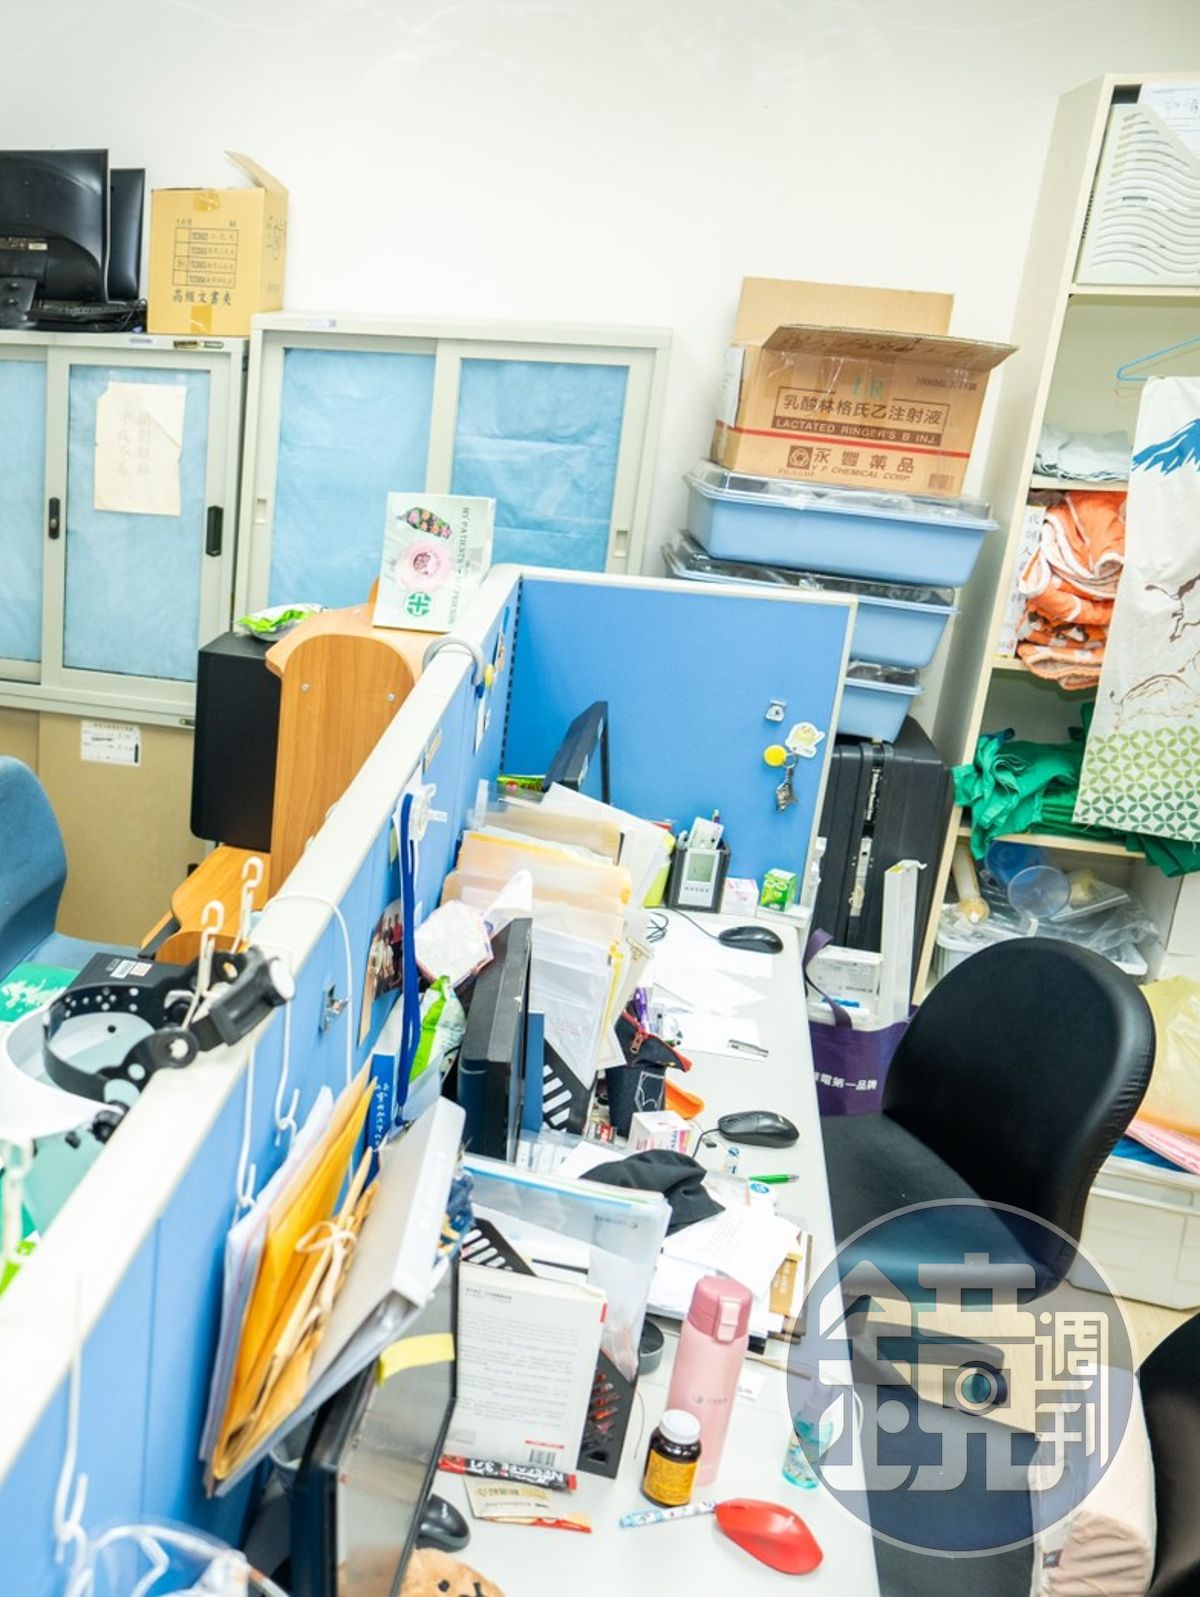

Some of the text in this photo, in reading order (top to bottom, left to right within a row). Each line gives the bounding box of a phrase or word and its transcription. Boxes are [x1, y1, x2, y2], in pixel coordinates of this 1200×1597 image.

[783, 393, 942, 426] 乳酸林格氏乙注射液
[775, 419, 939, 444] LACTATED RINGER'S B INJ.
[831, 466, 878, 479] CHEMICAL
